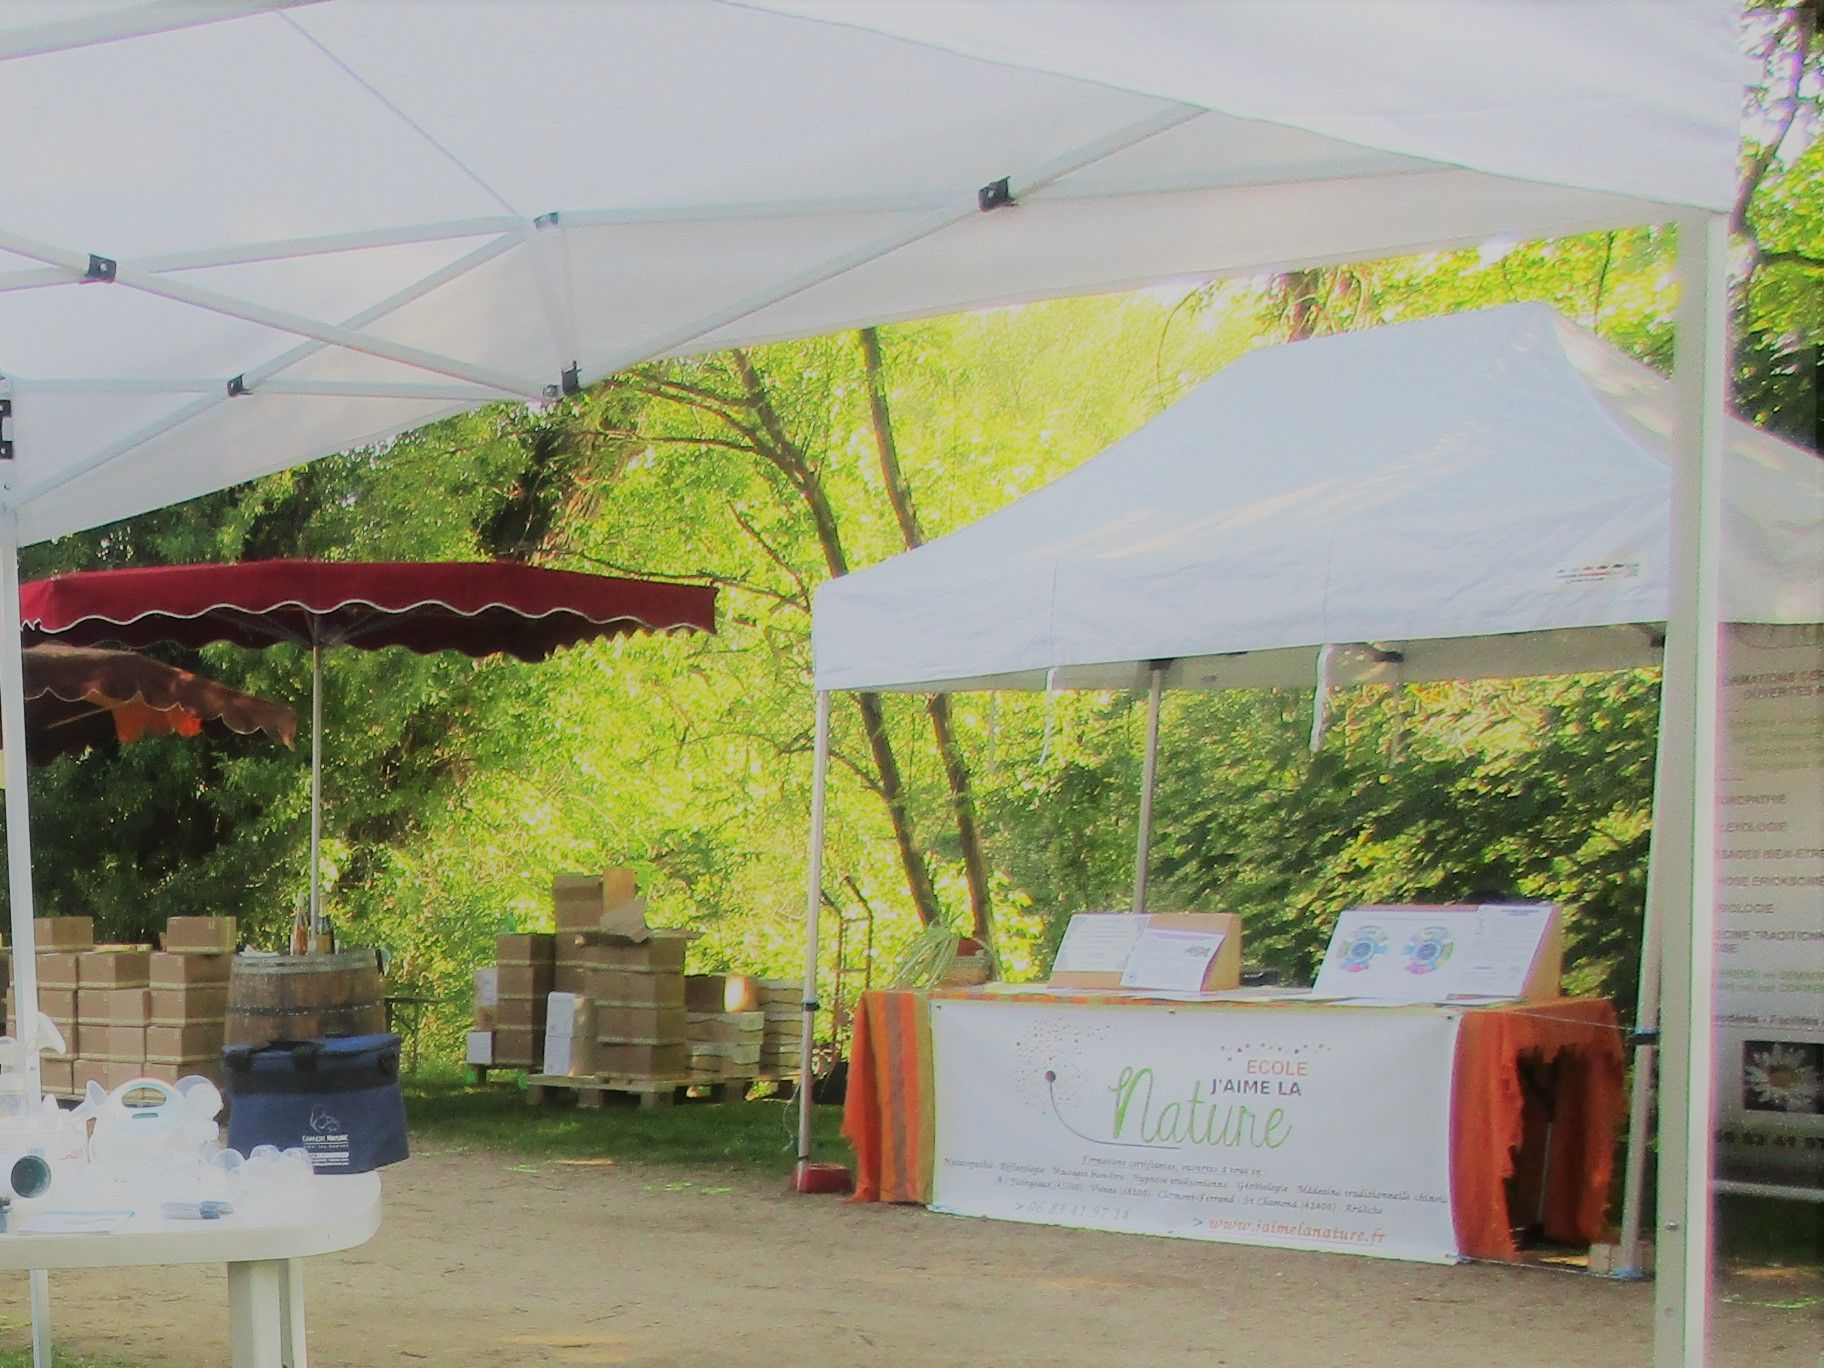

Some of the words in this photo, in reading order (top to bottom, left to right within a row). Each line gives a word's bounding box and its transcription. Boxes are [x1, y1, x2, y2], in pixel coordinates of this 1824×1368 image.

[1247, 1059, 1308, 1076] ECOLE
[1210, 1078, 1270, 1095] J'AIME
[1278, 1081, 1303, 1096] LA
[1108, 1066, 1292, 1149] Nature
[1208, 1216, 1388, 1244] www.jaimelanature.fr
